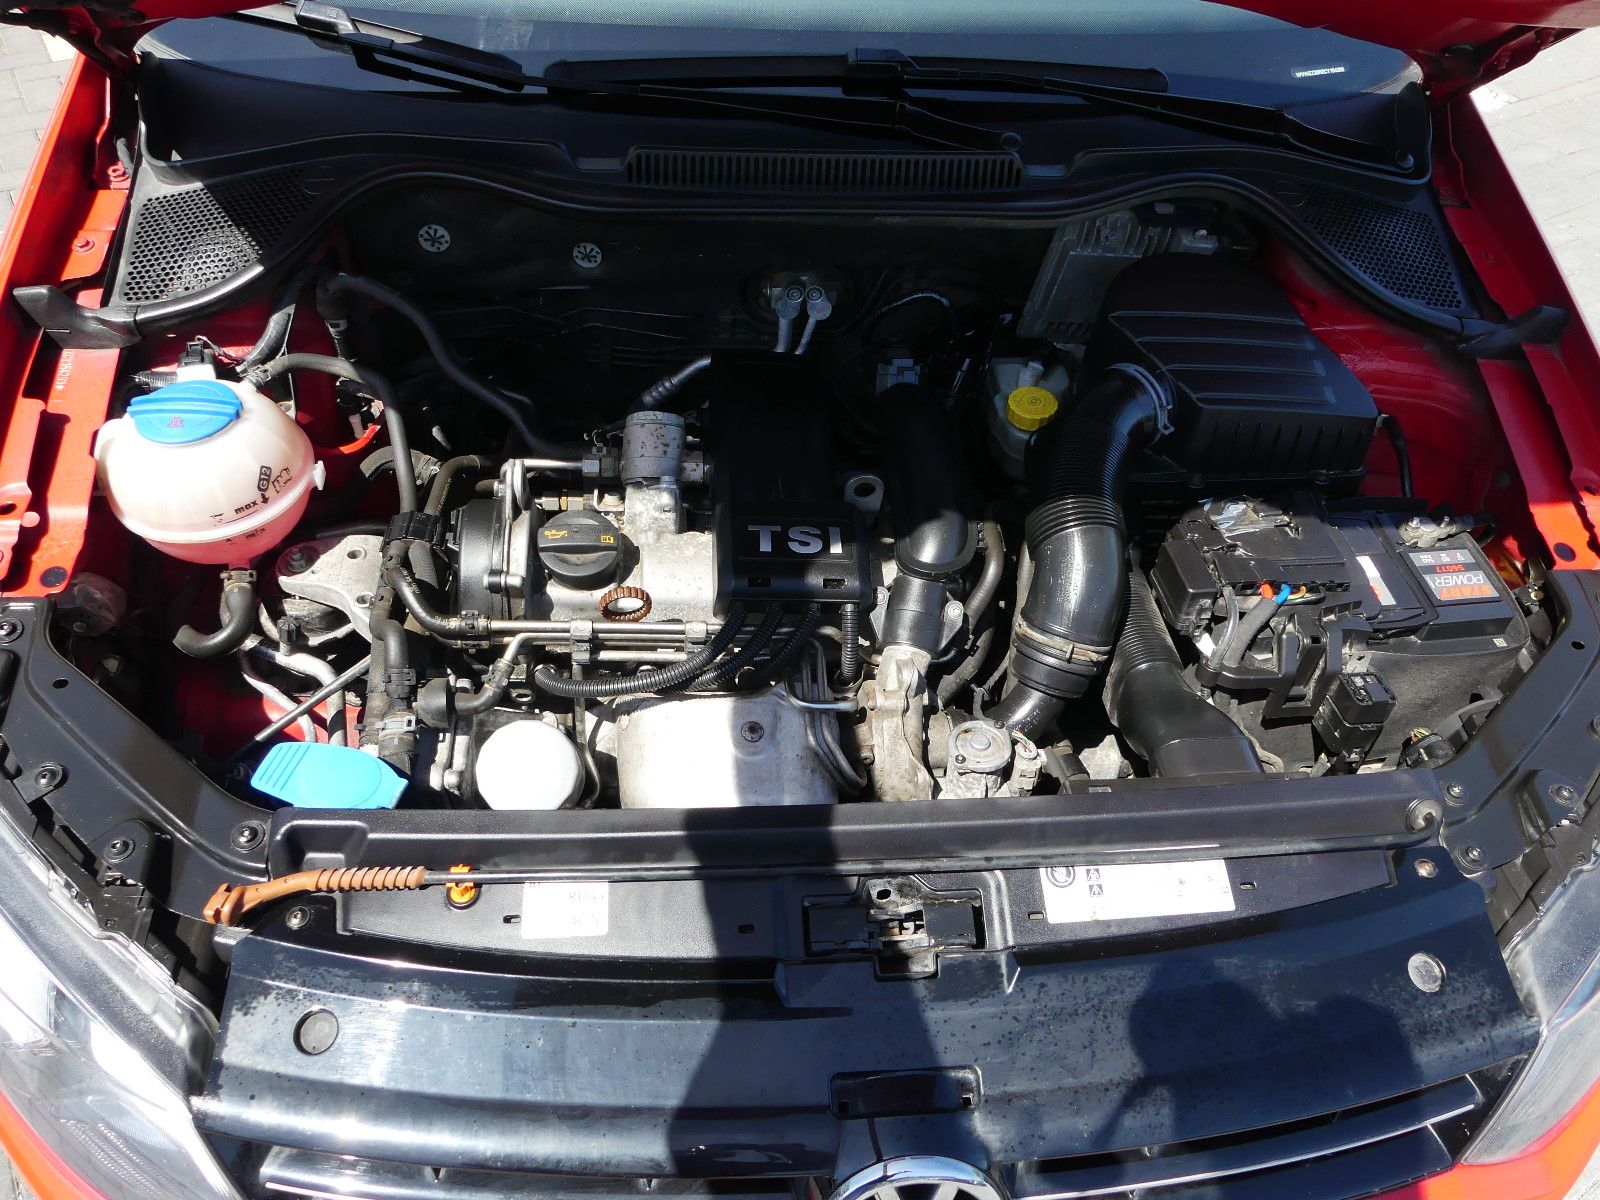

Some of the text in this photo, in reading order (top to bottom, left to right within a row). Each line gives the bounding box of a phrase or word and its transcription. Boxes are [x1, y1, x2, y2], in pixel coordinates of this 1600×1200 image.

[259, 466, 271, 491] G12
[234, 500, 258, 514] max
[747, 524, 843, 554] TSI
[1436, 574, 1483, 587] POWER
